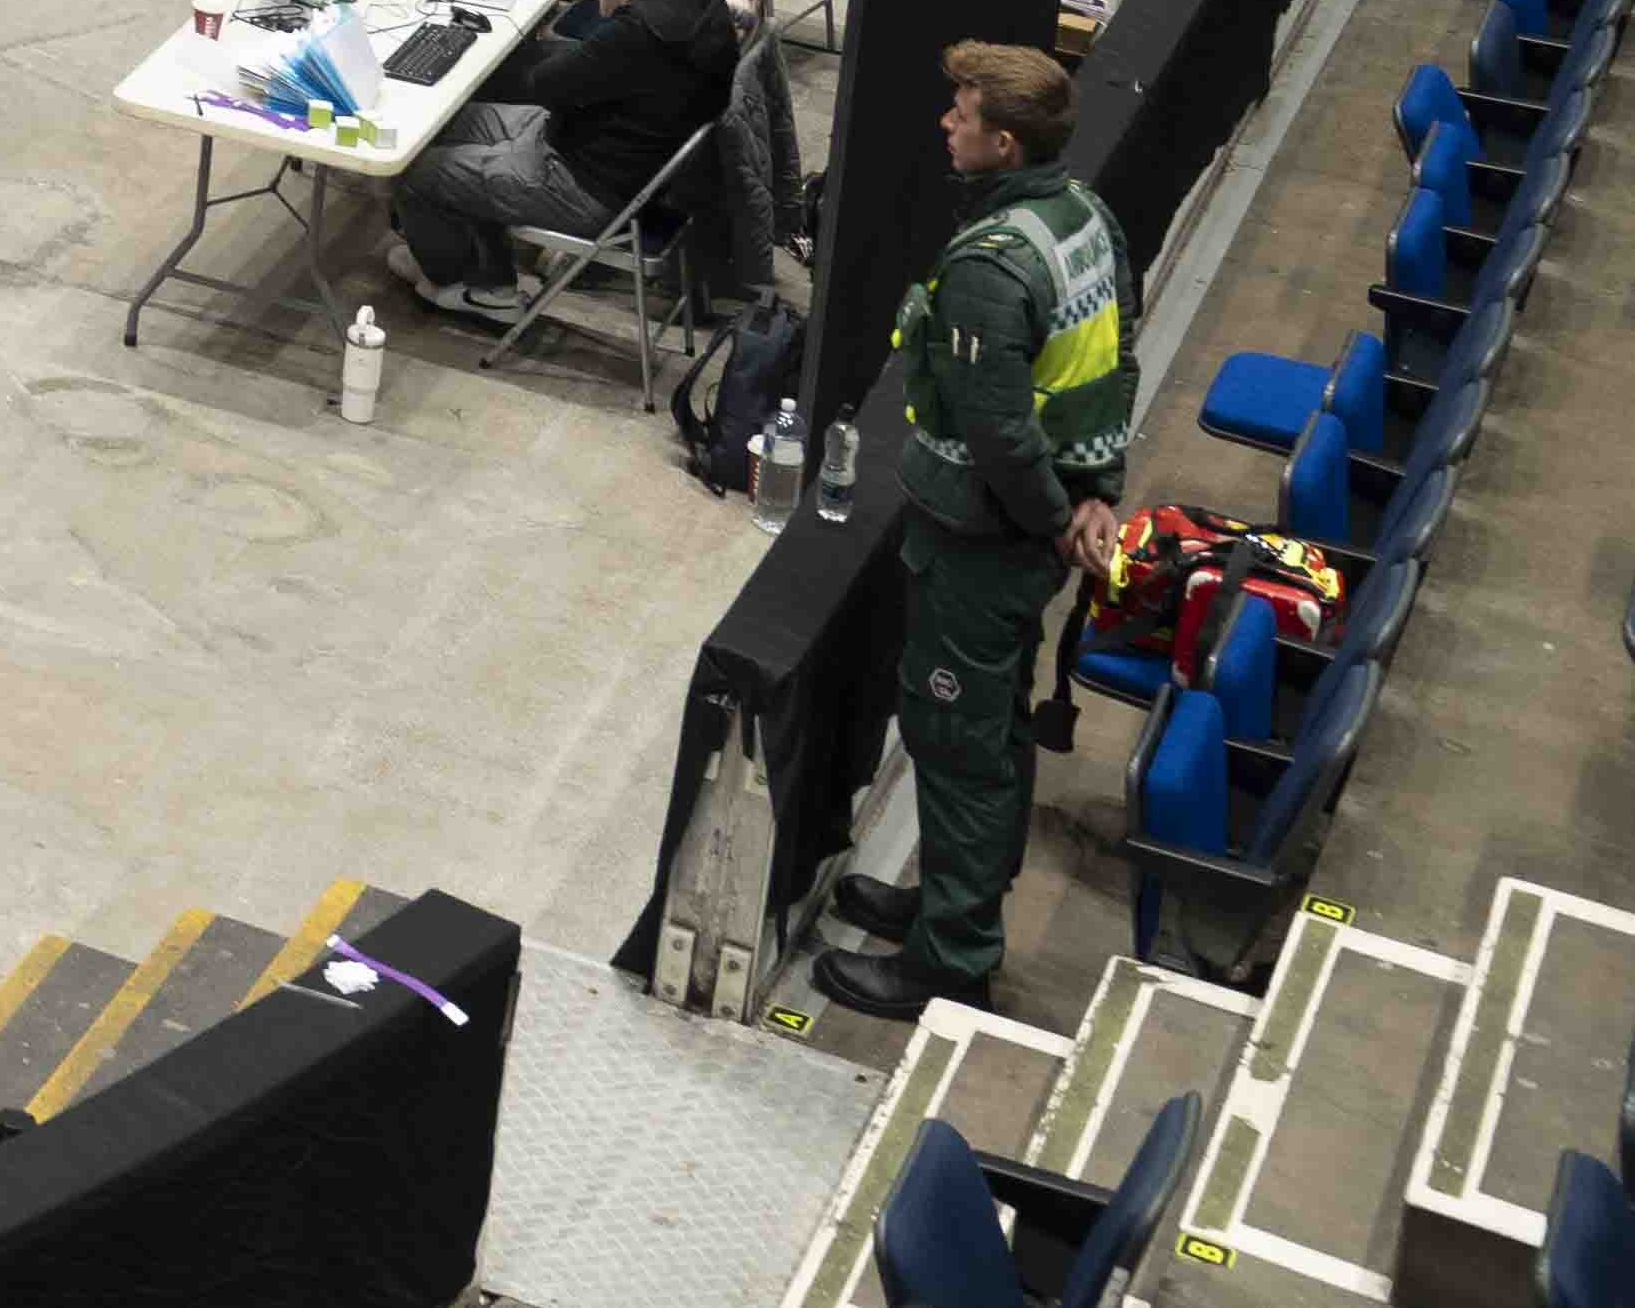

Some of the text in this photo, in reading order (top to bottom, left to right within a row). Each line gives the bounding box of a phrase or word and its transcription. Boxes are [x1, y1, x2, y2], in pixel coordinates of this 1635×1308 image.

[1310, 899, 1345, 922] B
[774, 1012, 805, 1030] A
[1186, 1239, 1225, 1265] B
